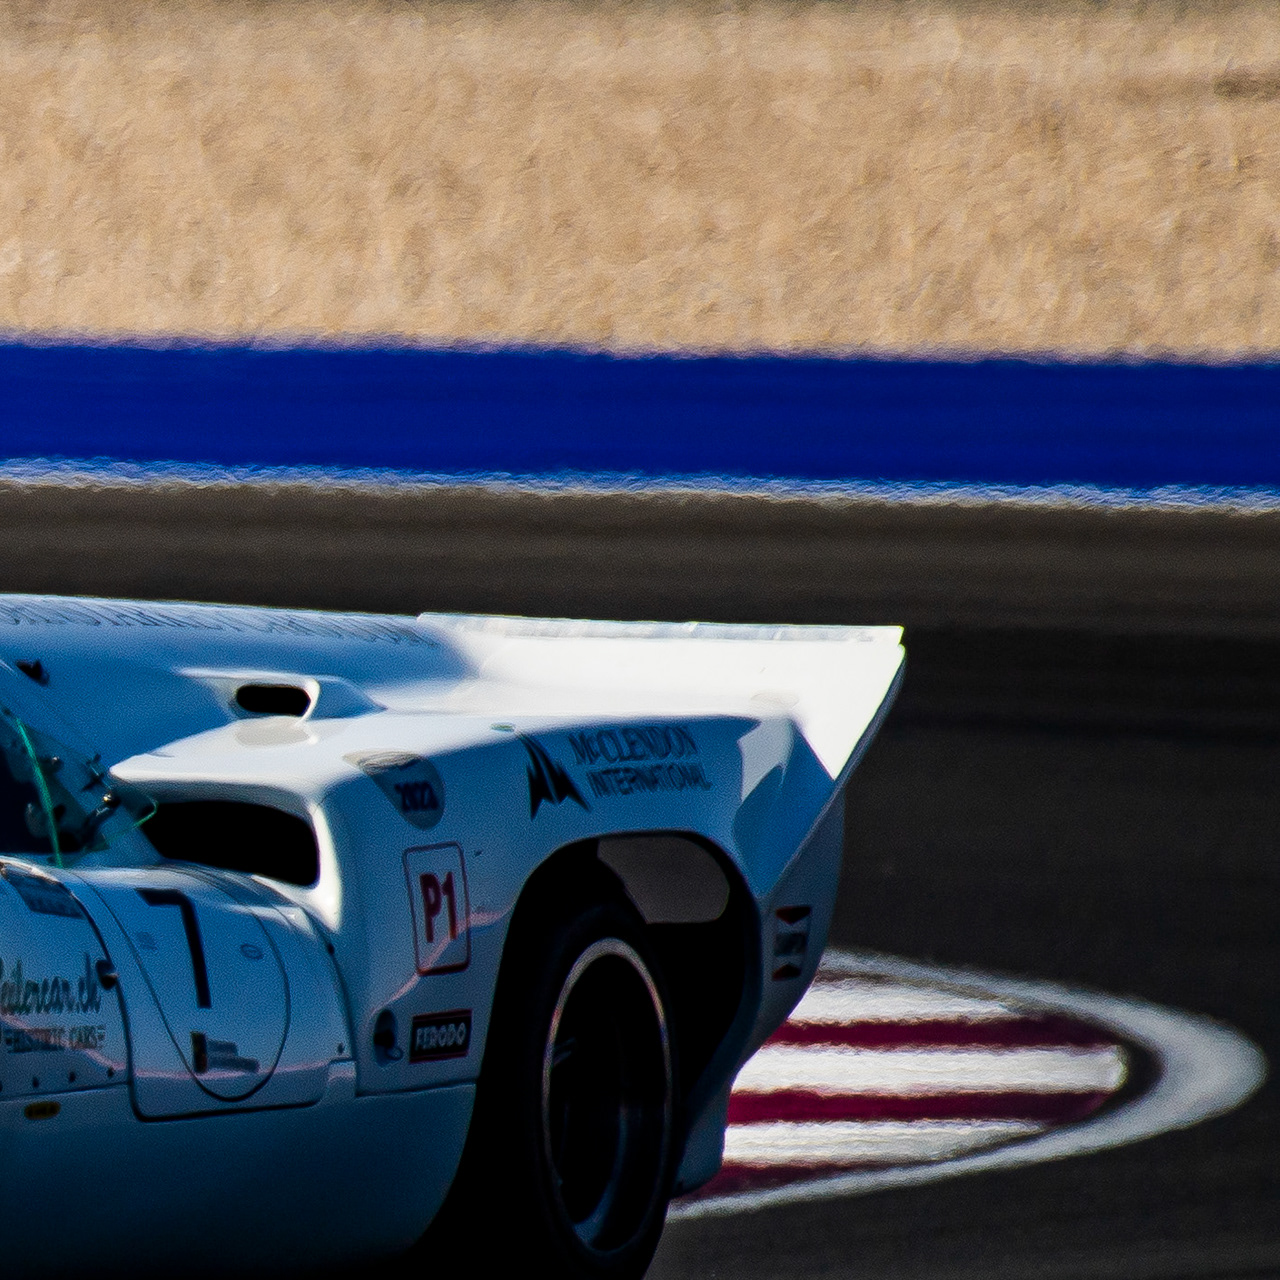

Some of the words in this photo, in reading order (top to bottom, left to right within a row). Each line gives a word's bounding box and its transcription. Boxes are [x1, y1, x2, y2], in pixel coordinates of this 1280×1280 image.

[419, 871, 458, 943] P1
[134, 887, 212, 1009] 7
[416, 1021, 467, 1052] FERODO
